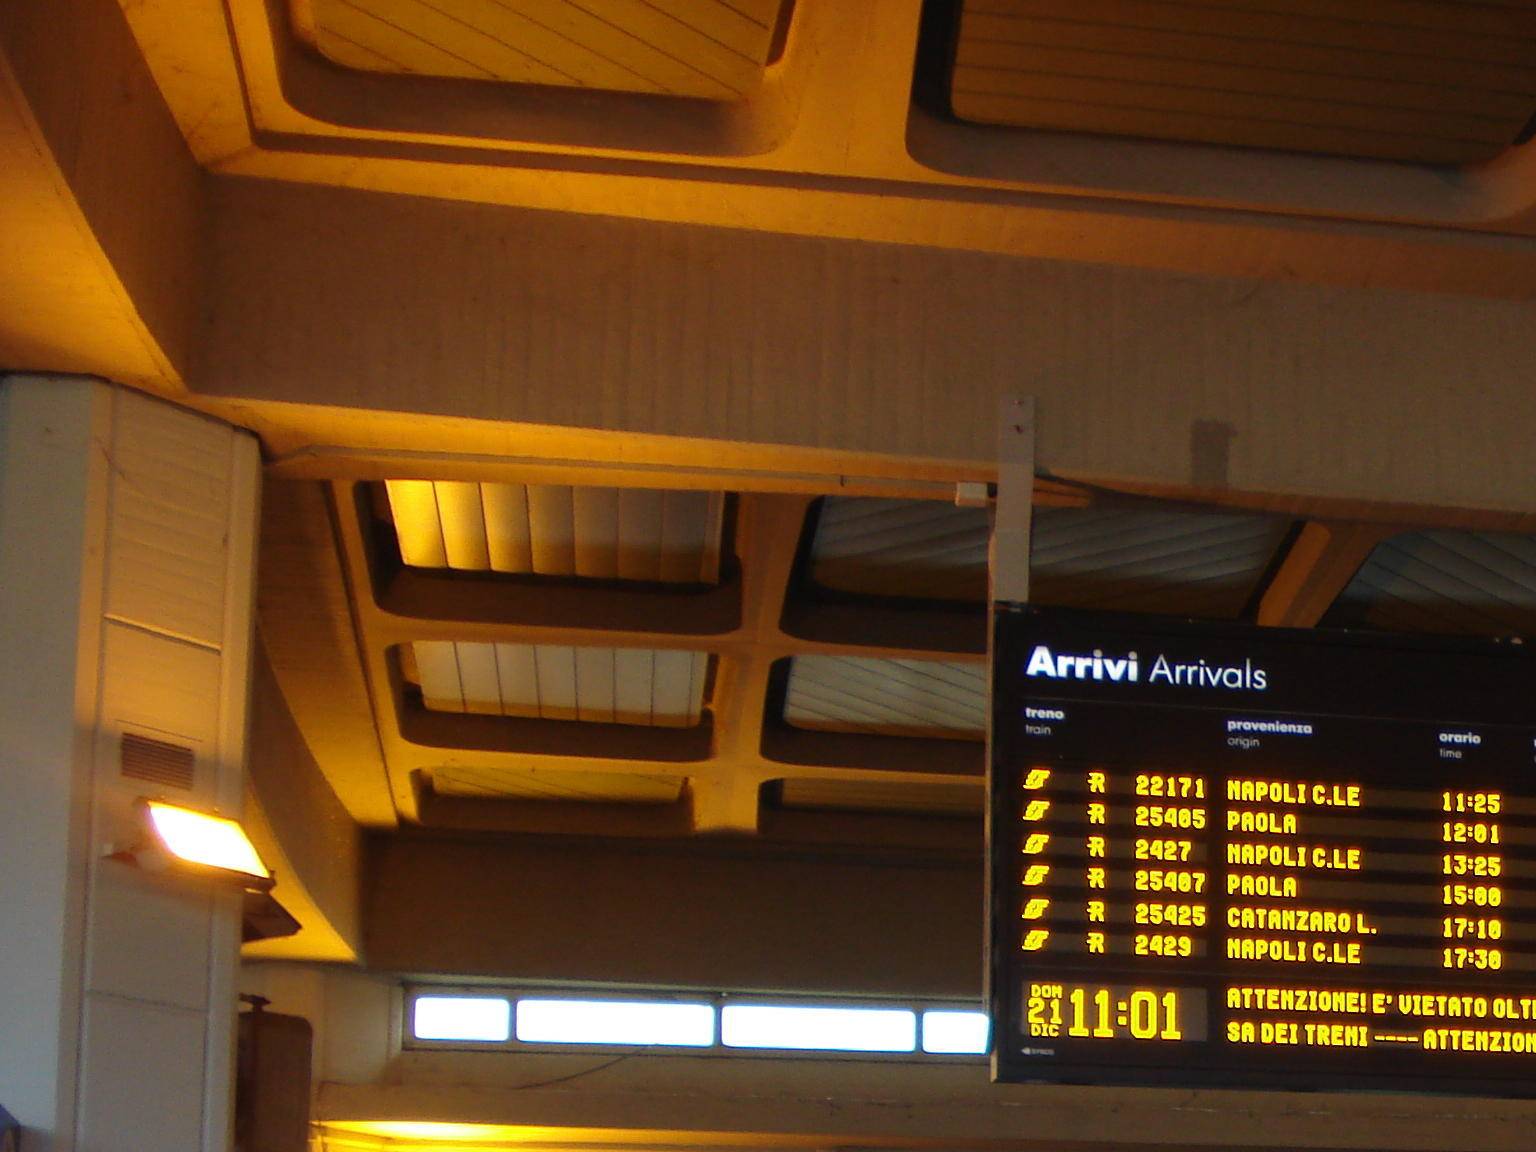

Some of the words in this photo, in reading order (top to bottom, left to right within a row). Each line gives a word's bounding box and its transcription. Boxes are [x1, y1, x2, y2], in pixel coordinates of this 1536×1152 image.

[1025, 645, 1139, 682] Arrivi
[1148, 654, 1267, 690] Arrivals
[1025, 707, 1065, 721] treno
[1226, 719, 1313, 735] provenienza
[1025, 723, 1052, 736] train
[1438, 731, 1482, 745] orario
[1227, 736, 1260, 750] origin
[1439, 747, 1463, 759] time
[1135, 774, 1205, 799] 22171
[1227, 779, 1306, 804] NAPOLI
[1312, 784, 1360, 807] C.LE
[1442, 791, 1501, 814] 11:25
[1135, 805, 1206, 829] 25405
[1227, 810, 1297, 834] PAOLA
[1443, 822, 1499, 844] 12:01
[1135, 838, 1192, 862] 2427
[1227, 843, 1307, 867] NAPOLI
[1312, 847, 1361, 870] C.LE
[1443, 854, 1502, 877] 13:25
[1135, 869, 1206, 893] 25407
[1227, 873, 1297, 898] PAOLA
[1443, 884, 1502, 907] 15:00
[1135, 902, 1206, 927] 25425
[1227, 906, 1351, 933] CATANZARO
[1356, 913, 1377, 934] L.
[1443, 917, 1502, 940] 17:10
[1134, 934, 1192, 957] 2429
[1227, 937, 1307, 962] NAPOLI
[1312, 941, 1361, 964] C.LE
[1443, 947, 1502, 970] 17:30
[1029, 983, 1063, 999] DOM
[1227, 987, 1367, 1013] ATTENZIONE!
[1372, 992, 1393, 1014] E'
[1398, 994, 1488, 1018] VIETATO
[1028, 999, 1063, 1024] 21
[1068, 988, 1182, 1040] 11:01
[1030, 1023, 1063, 1037] DIC
[1227, 1021, 1256, 1044] SA
[1260, 1022, 1299, 1045] DEI
[1304, 1023, 1368, 1047] TRENI
